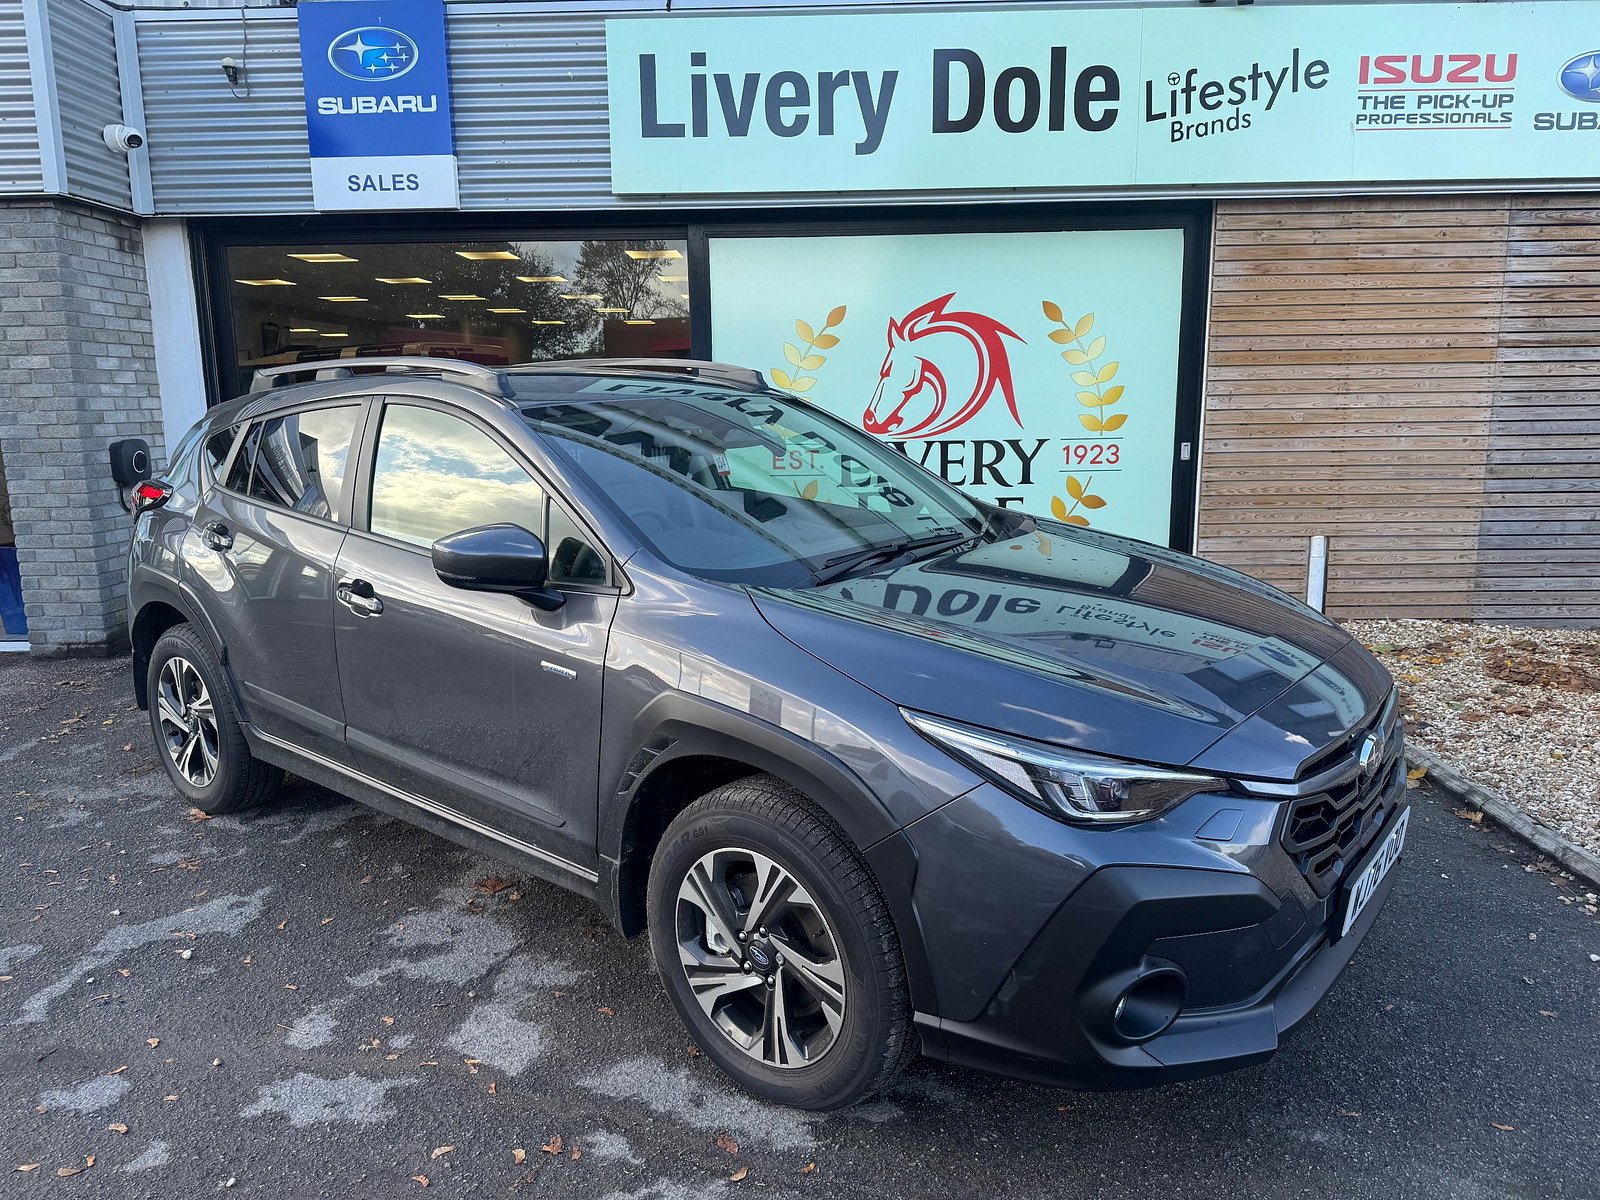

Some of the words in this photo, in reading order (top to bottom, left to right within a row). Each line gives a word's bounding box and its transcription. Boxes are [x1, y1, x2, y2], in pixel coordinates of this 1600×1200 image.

[1358, 53, 1518, 85] ISUZU
[1145, 48, 1330, 122] Lifestyle
[317, 95, 437, 115] SUBARU
[639, 52, 899, 155] Livery
[932, 46, 1121, 133] Dole
[1357, 95, 1406, 110] THE
[1416, 93, 1515, 109] PICK-UP
[1170, 106, 1252, 143] Brands
[1355, 111, 1513, 126] PROFESSIONALS
[1534, 112, 1600, 130] SUB
[347, 173, 420, 192] SALES
[771, 449, 824, 471] EST.
[1062, 444, 1121, 466] 1923
[692, 826, 709, 838] G91
